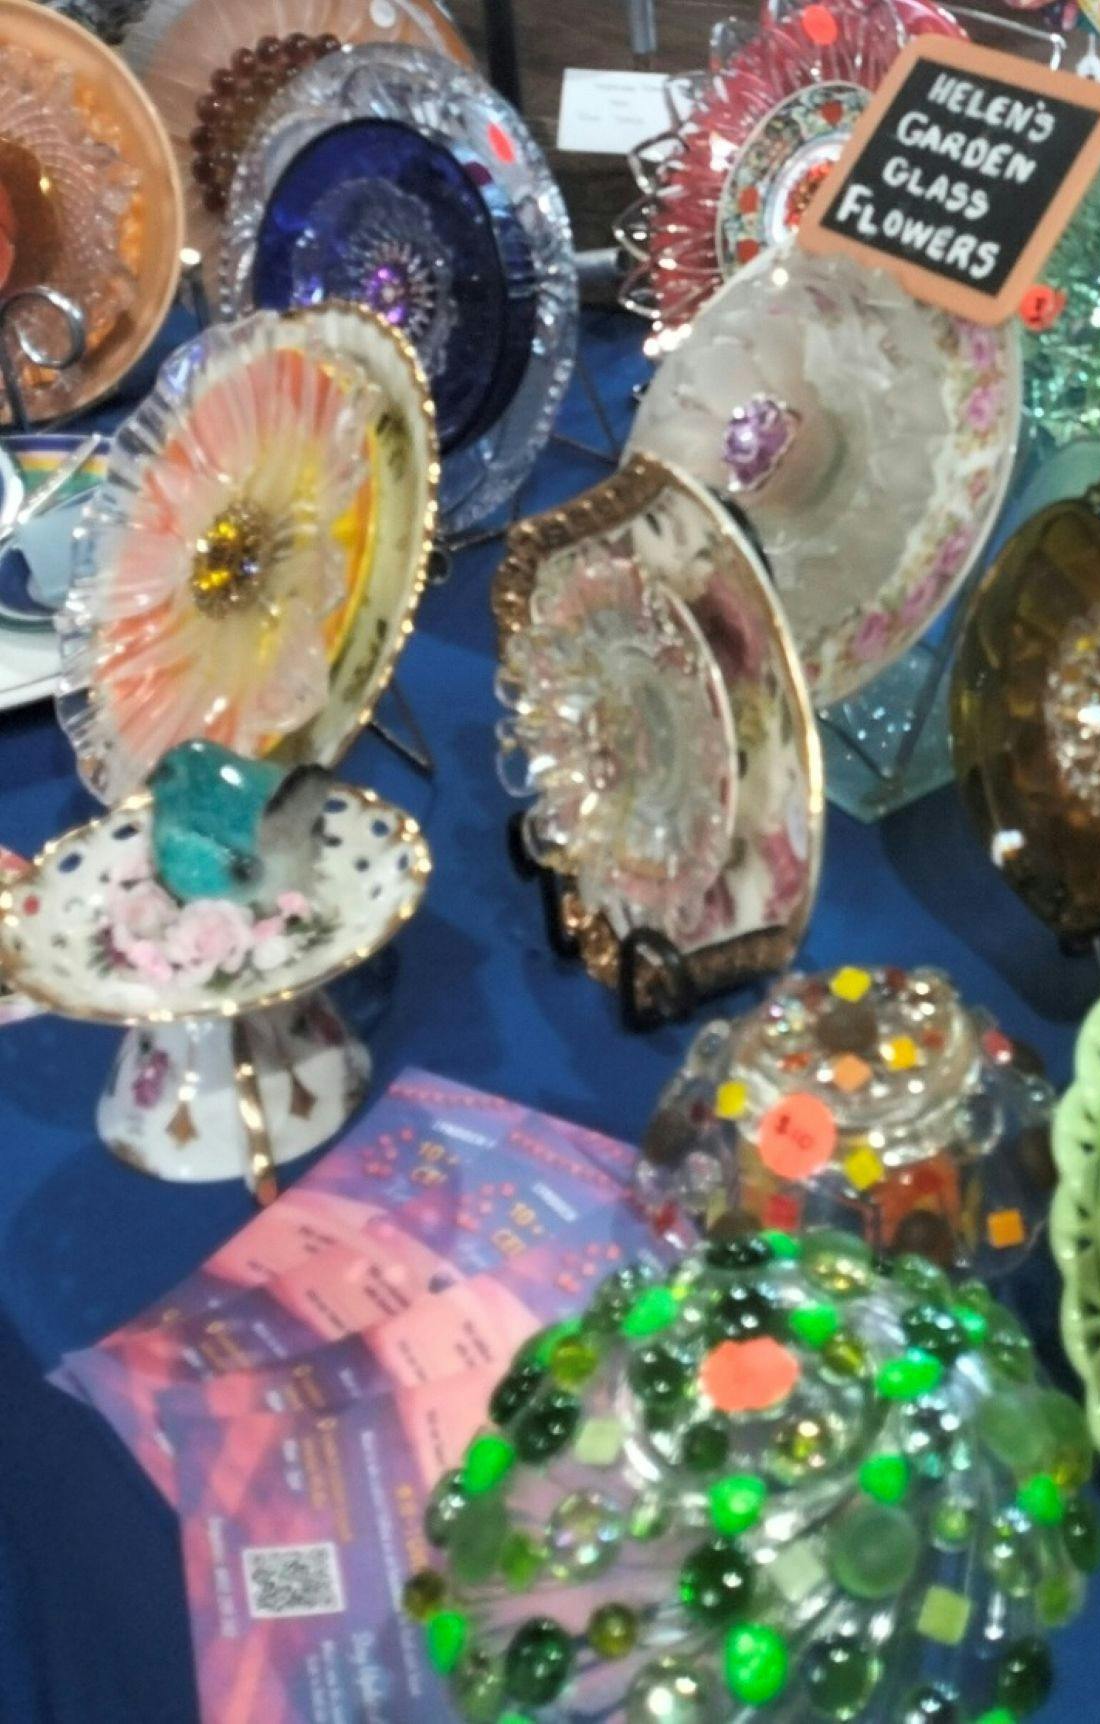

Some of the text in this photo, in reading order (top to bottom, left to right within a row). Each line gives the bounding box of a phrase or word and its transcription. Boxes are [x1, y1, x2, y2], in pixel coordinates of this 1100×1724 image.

[928, 73, 1055, 143] HELEN'S
[897, 111, 1037, 184] GARDEN
[882, 157, 990, 219] GLASS
[836, 184, 1000, 279] FLOWERS
